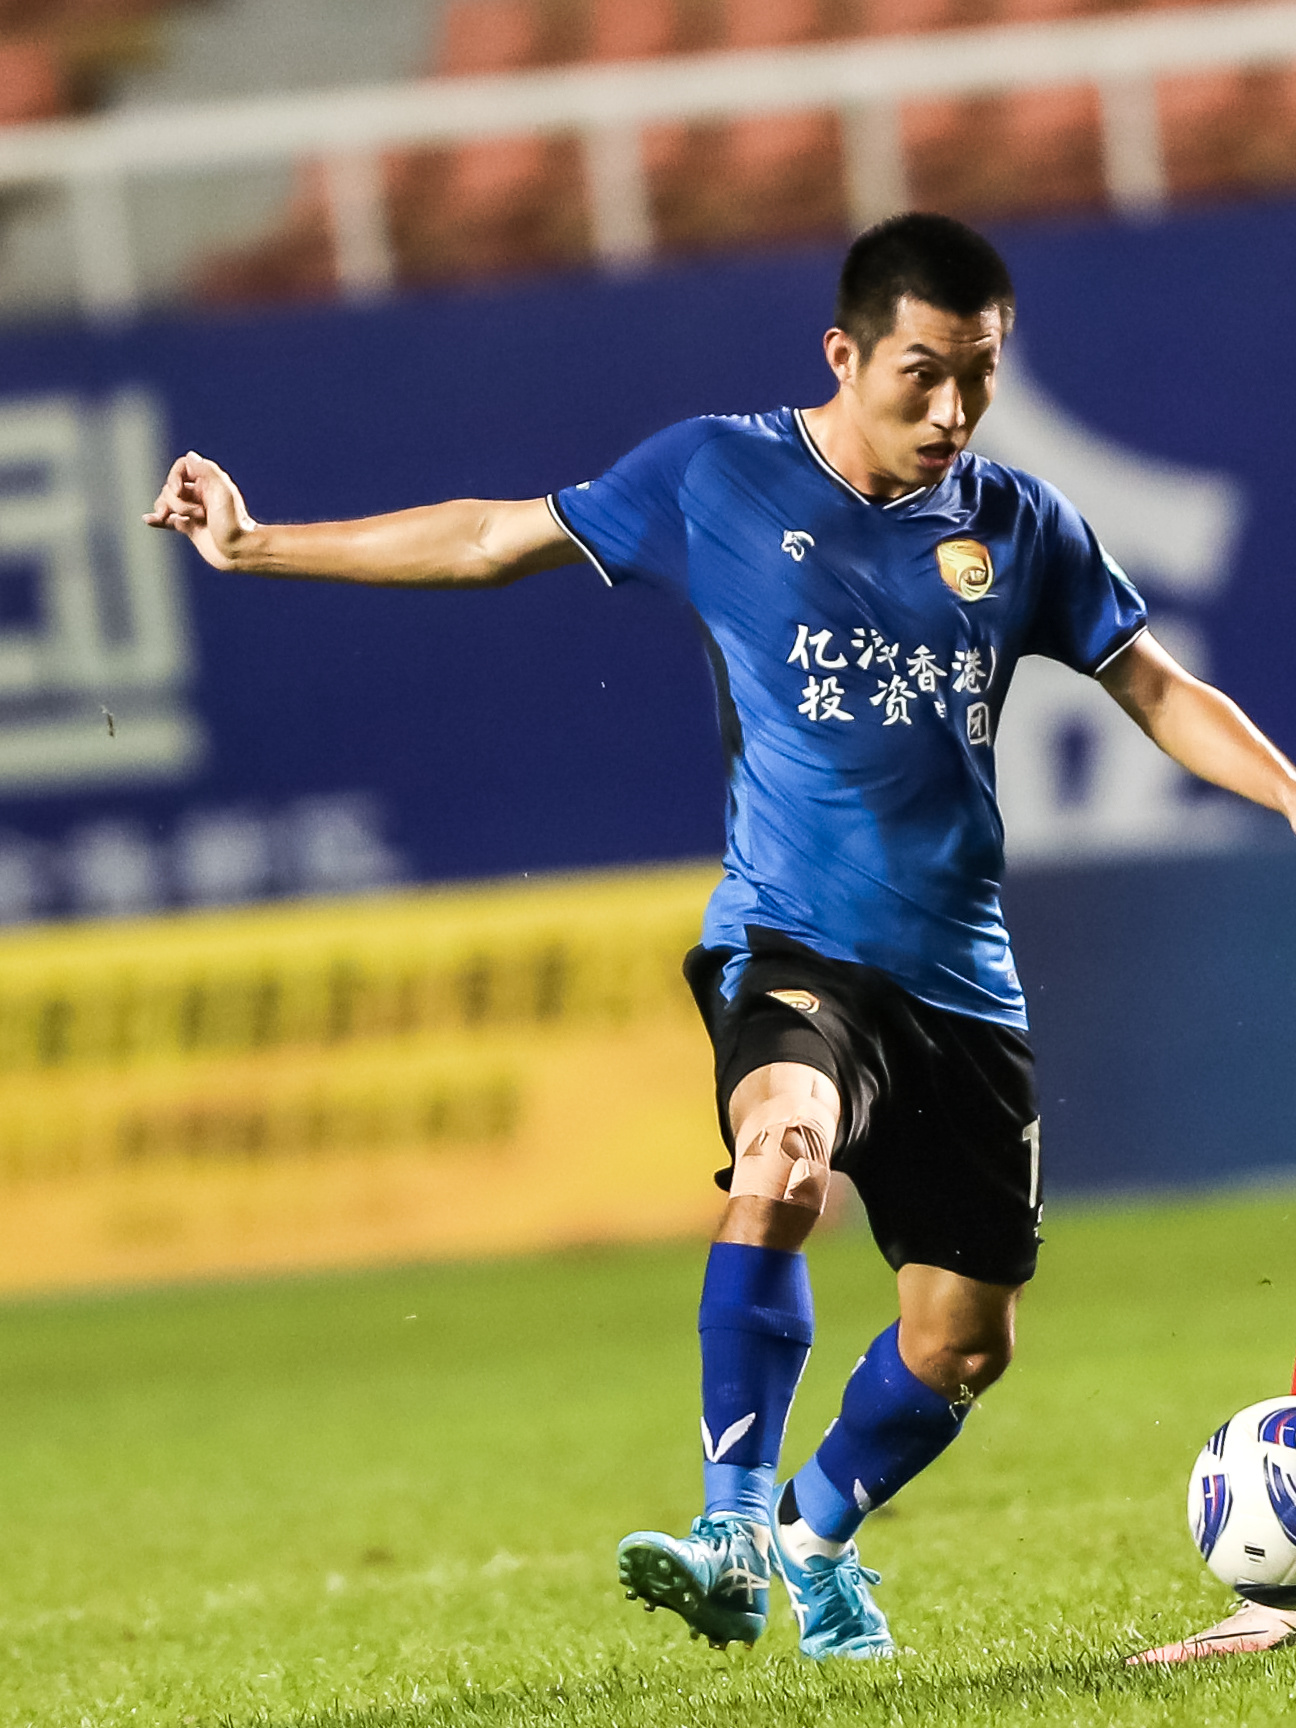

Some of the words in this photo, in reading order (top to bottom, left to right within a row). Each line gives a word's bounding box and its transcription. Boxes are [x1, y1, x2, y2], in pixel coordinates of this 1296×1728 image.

[798, 674, 993, 747] 投资团
[1022, 1114, 1041, 1208] 1
